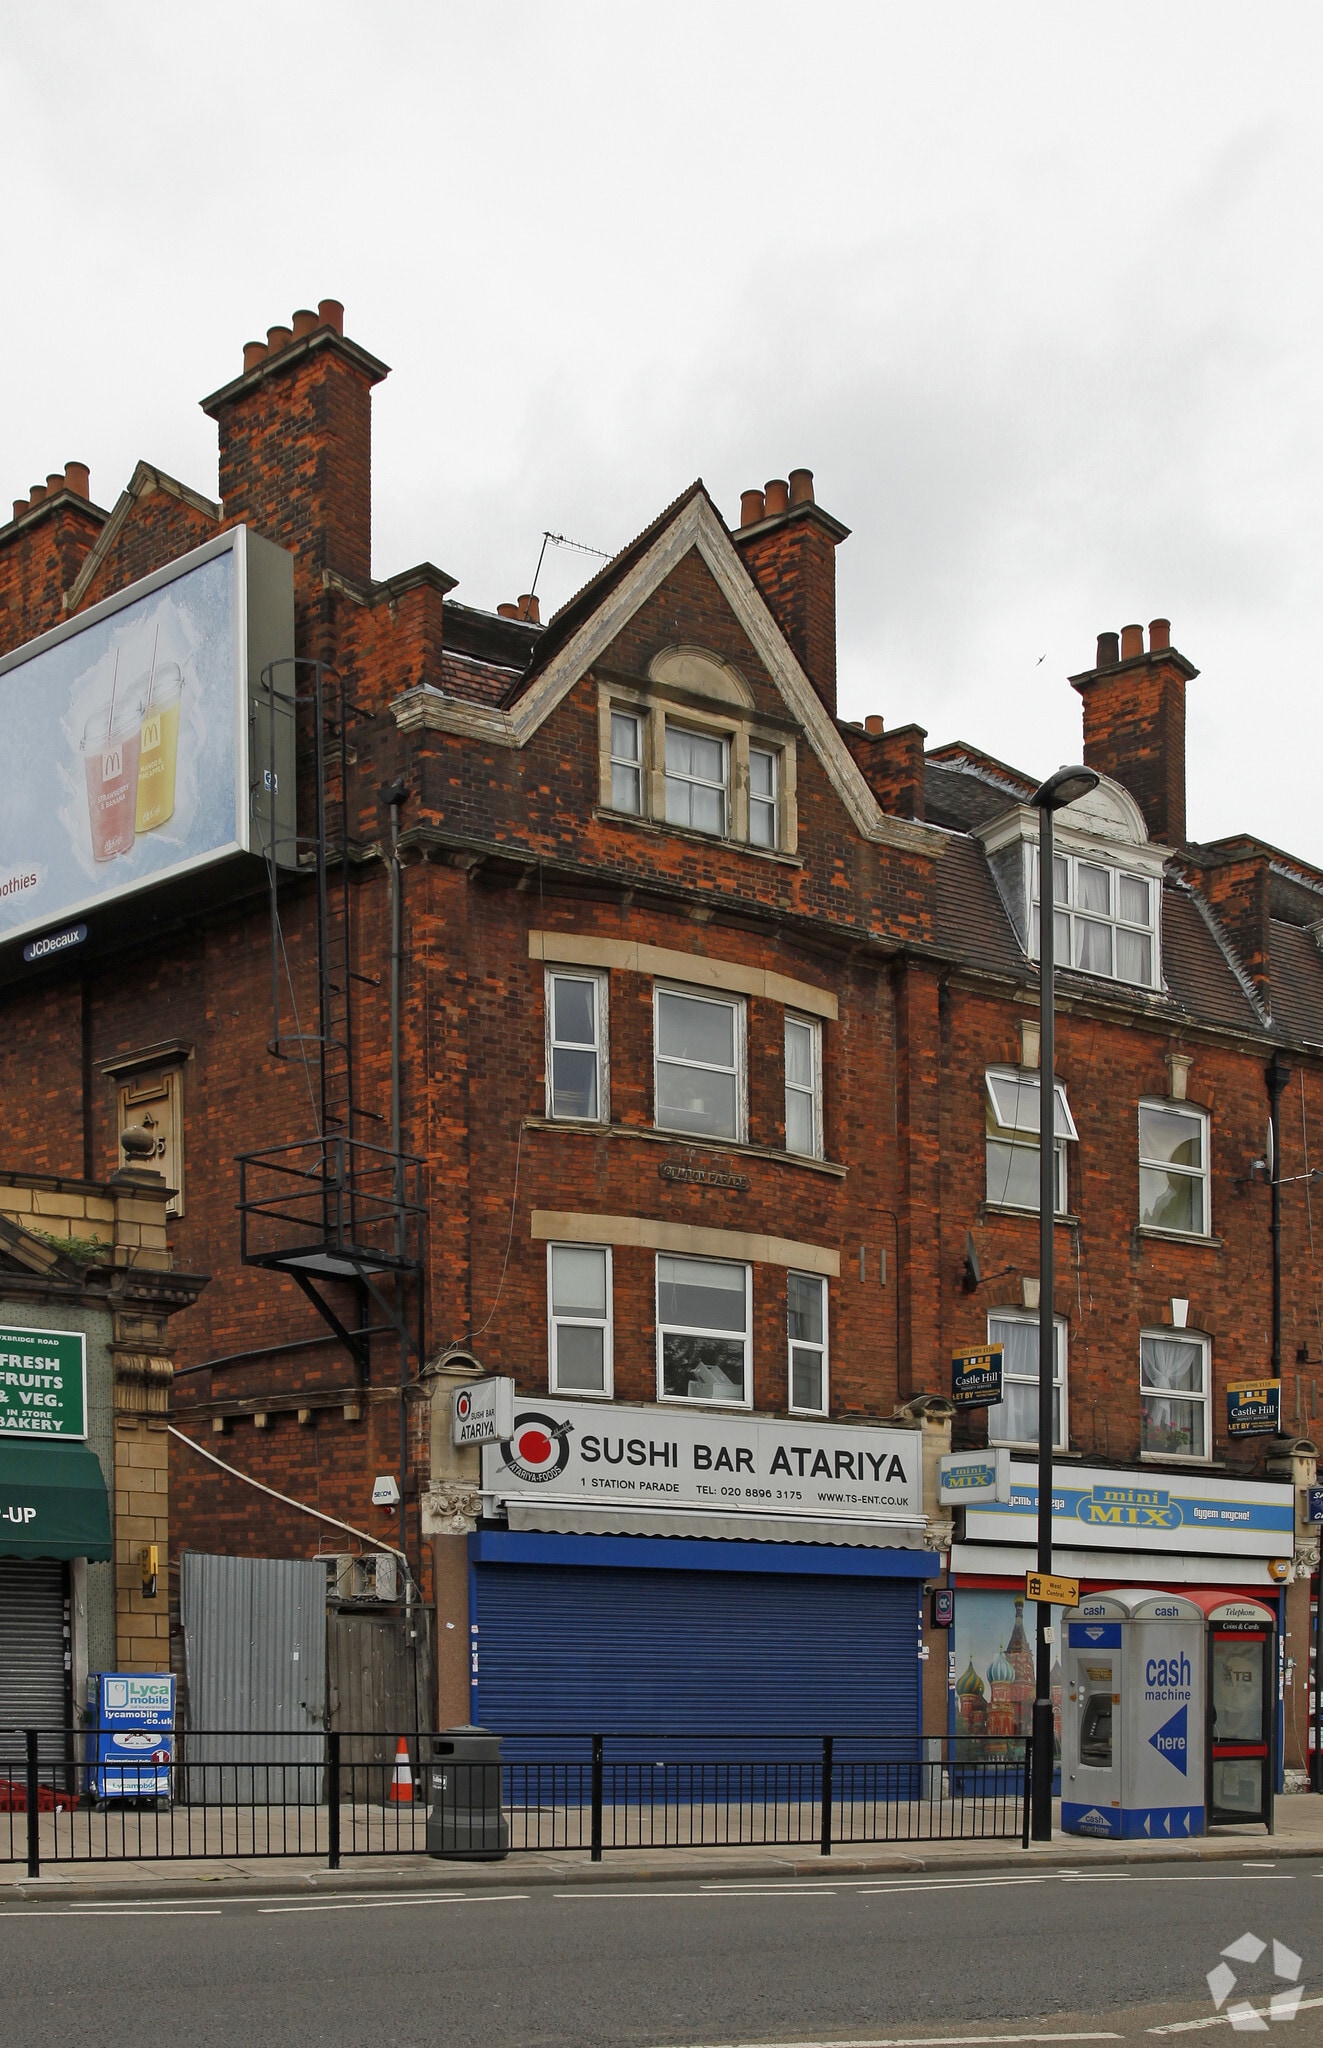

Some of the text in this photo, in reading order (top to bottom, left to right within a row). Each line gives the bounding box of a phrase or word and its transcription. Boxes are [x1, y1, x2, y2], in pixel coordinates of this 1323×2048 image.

[30, 930, 80, 957] JCDecaux
[664, 1166, 747, 1189] STATION PARADE
[37, 1338, 60, 1346] ROAD
[0, 1353, 60, 1372] FRESH
[955, 1371, 998, 1386] Castle Hill
[18, 1391, 64, 1408] VEG.
[964, 1391, 974, 1399] BY
[22, 1410, 52, 1419] STORE
[471, 1408, 495, 1420] SUSHI BAR
[1231, 1405, 1275, 1417] Castle Hill
[460, 1420, 495, 1441] ATARIYA
[580, 1435, 907, 1484] SUSHI BAR ATARIYA
[956, 1465, 982, 1475] mini
[580, 1477, 679, 1493] 1 STATION PARADE
[948, 1475, 988, 1488] MIX
[696, 1485, 802, 1500] TEL: 020 8896 3175
[1104, 1489, 1159, 1505] mini
[817, 1492, 909, 1507] WWW.TS-ENT.CO.UK
[1087, 1505, 1171, 1527] MIX
[1049, 1582, 1062, 1590] West
[1046, 1589, 1065, 1598] Central
[1083, 1605, 1106, 1616] cash
[1155, 1606, 1179, 1617] cash
[1225, 1607, 1256, 1617] Telephone
[1222, 1622, 1238, 1630] Coins
[1243, 1623, 1260, 1631] Cards
[1145, 1650, 1191, 1687] cash
[130, 1682, 169, 1698] Lyca
[1145, 1689, 1191, 1701] machine
[130, 1696, 169, 1705] mobile
[105, 1711, 158, 1719] lycamobile
[1157, 1734, 1186, 1750] here
[1085, 1815, 1104, 1824] cash
[1080, 1825, 1109, 1834] machine
